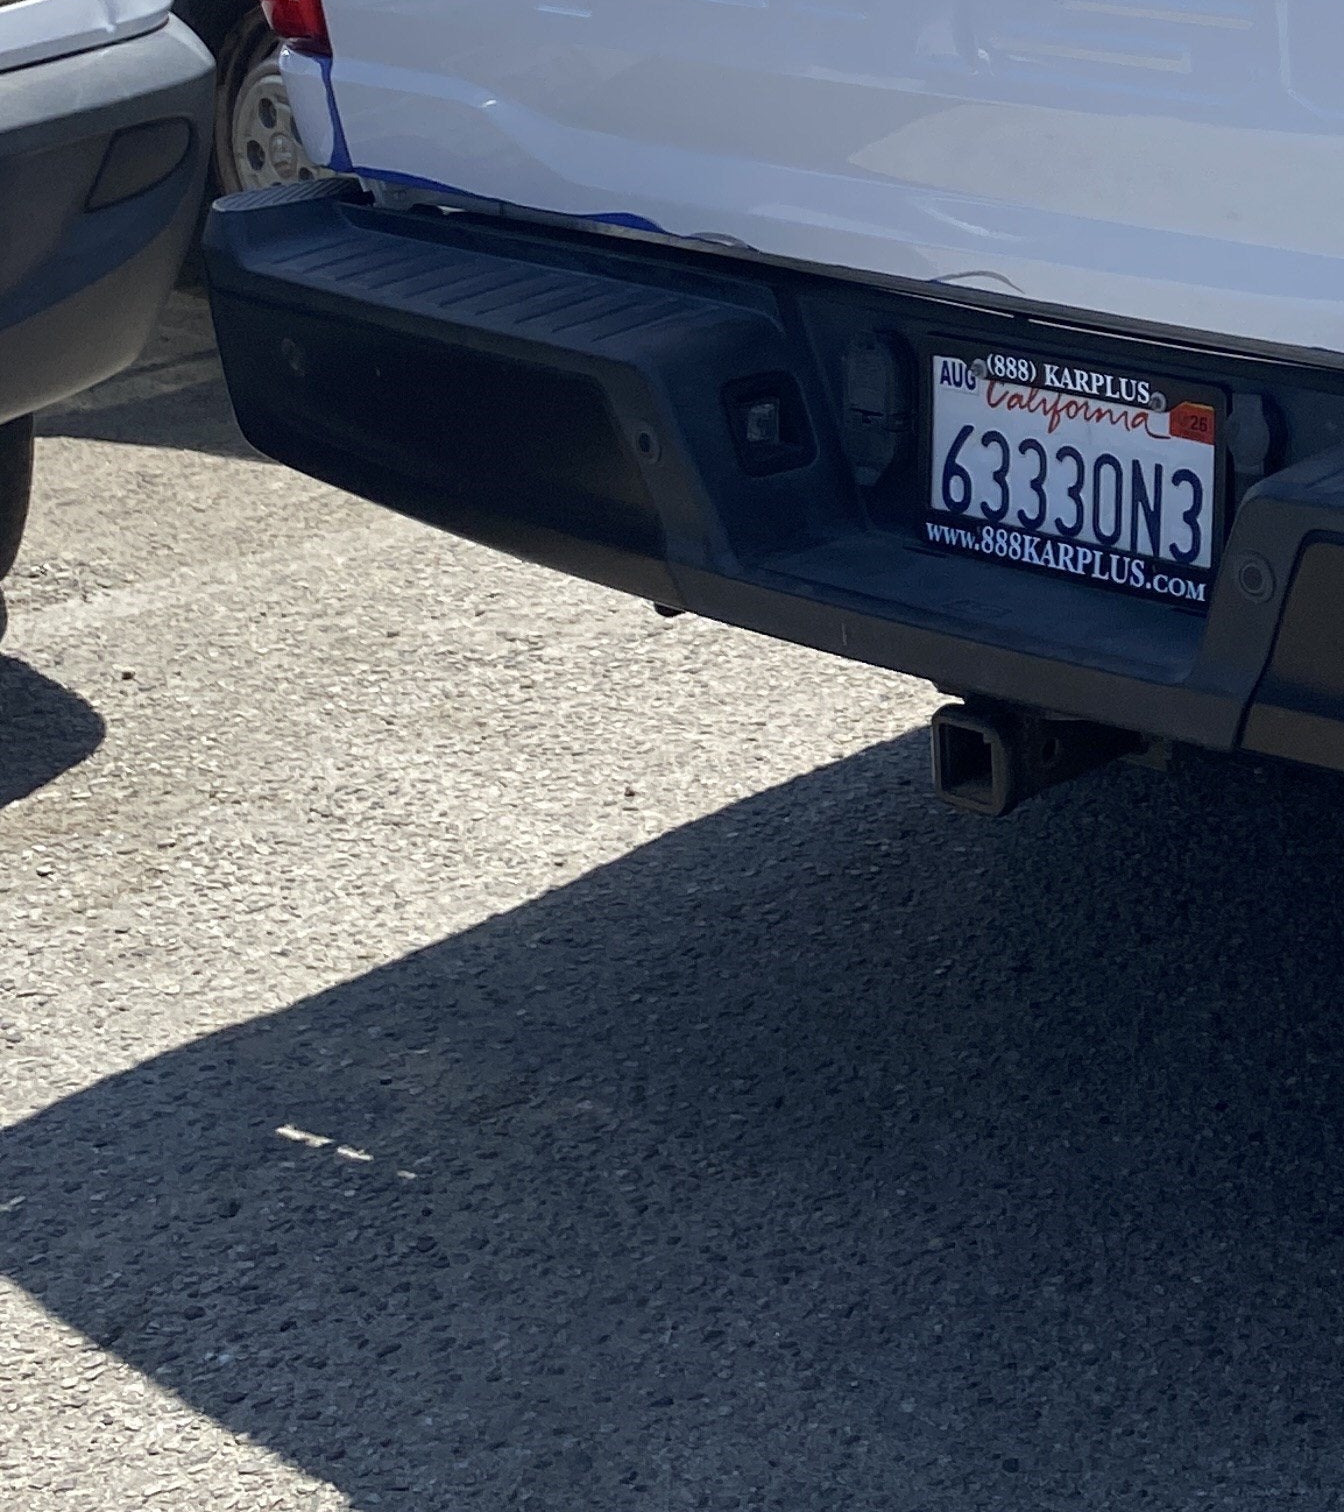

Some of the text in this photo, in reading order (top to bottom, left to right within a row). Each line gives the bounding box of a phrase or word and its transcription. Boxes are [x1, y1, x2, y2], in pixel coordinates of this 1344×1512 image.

[940, 360, 977, 391] AUG
[986, 353, 1151, 405] (888) KARPLUS
[985, 378, 1172, 441] California
[1190, 414, 1209, 432] 26
[941, 424, 1204, 564] 63330N3
